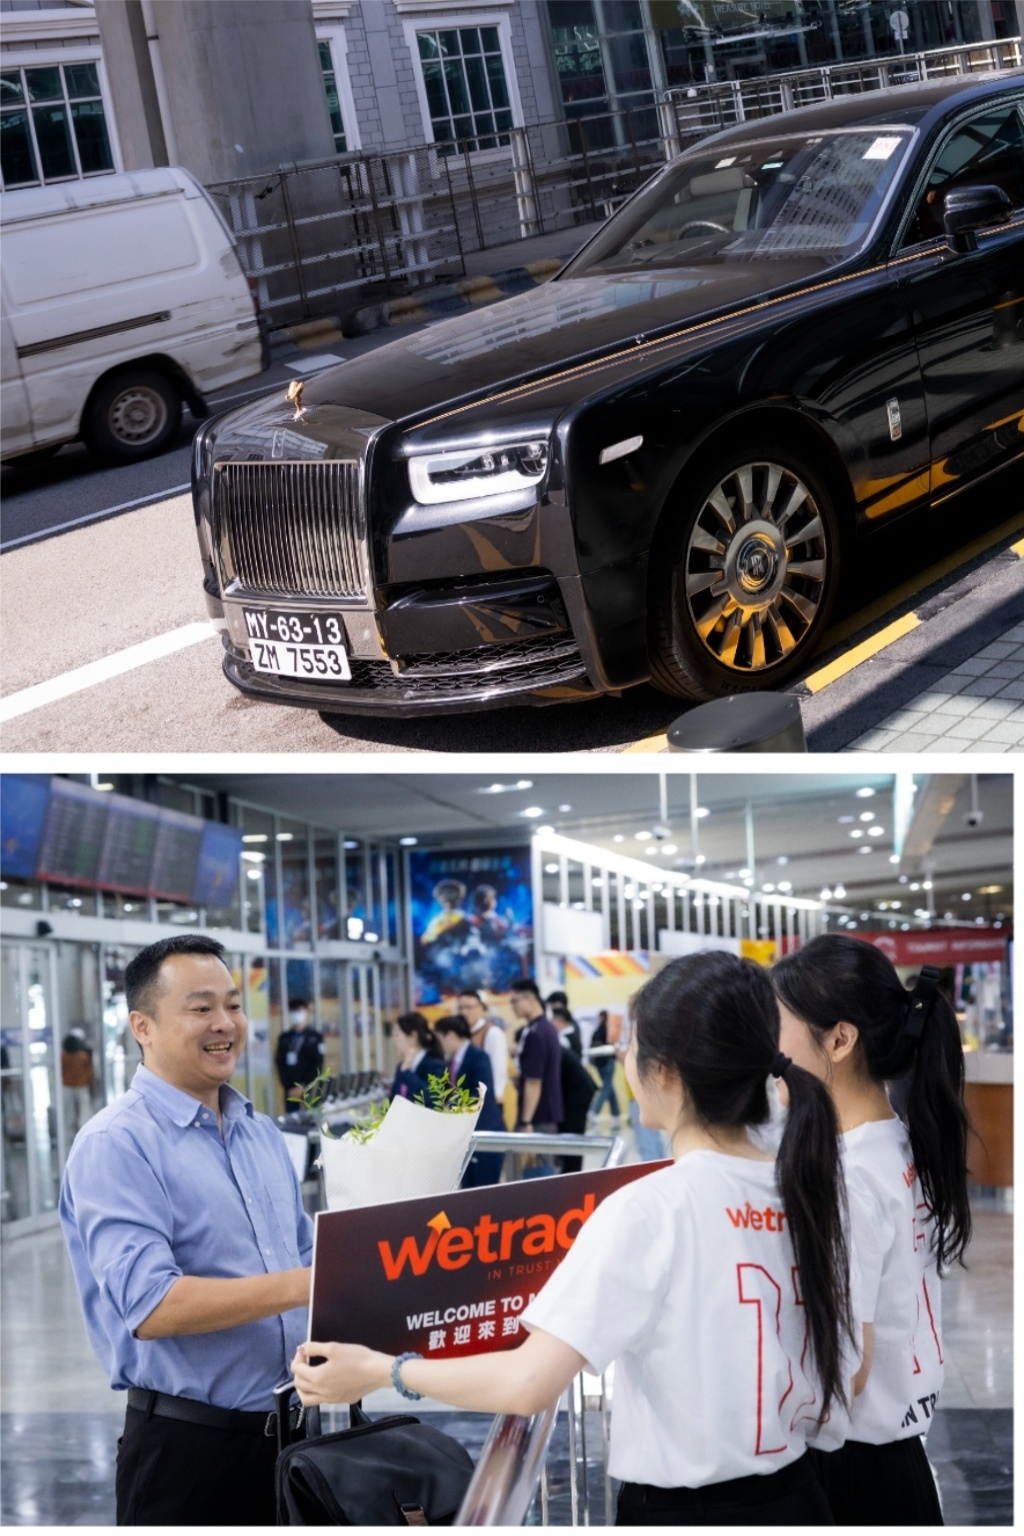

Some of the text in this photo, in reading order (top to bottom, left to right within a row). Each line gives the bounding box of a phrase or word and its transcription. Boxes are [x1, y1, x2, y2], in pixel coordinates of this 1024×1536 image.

[245, 612, 341, 644] MY-63-13
[254, 643, 342, 675] ZM 7553
[726, 1202, 787, 1232] wetr
[378, 1194, 595, 1281] wetrad
[488, 1260, 551, 1280] IN TRUST
[406, 1300, 496, 1331] WELCOME
[501, 1295, 524, 1313] TO
